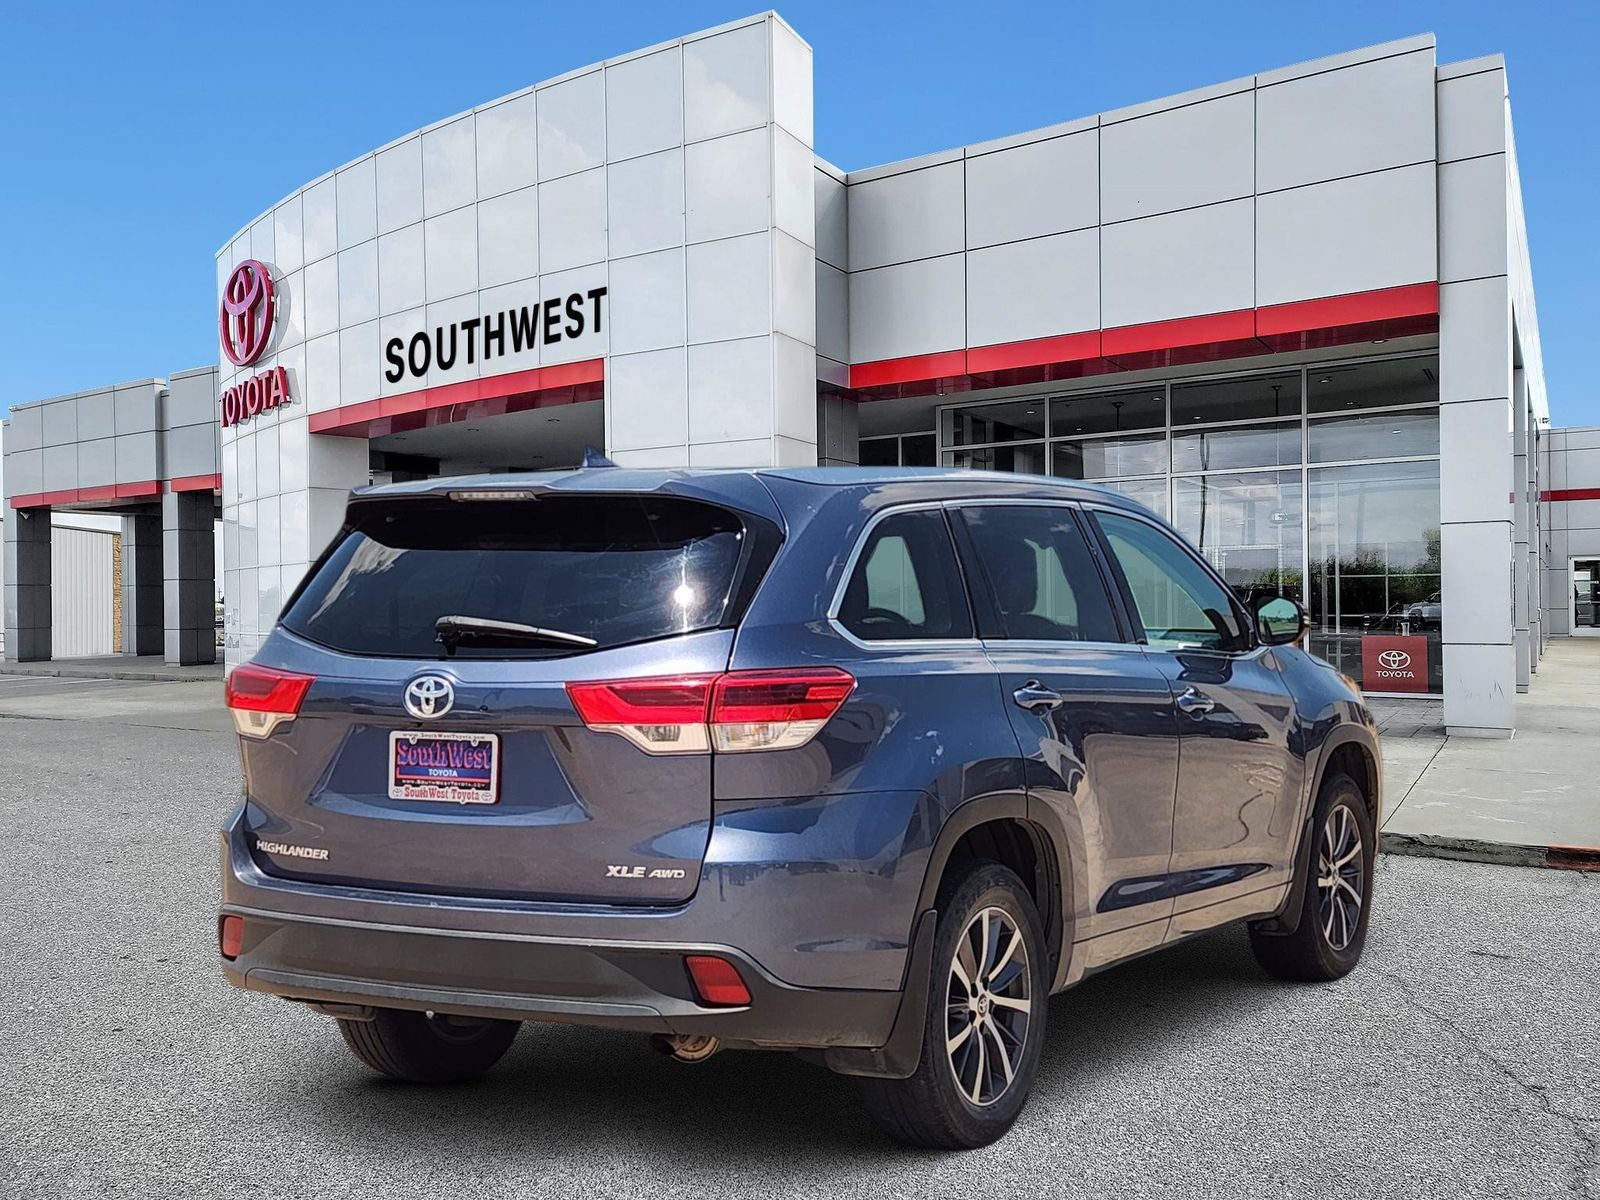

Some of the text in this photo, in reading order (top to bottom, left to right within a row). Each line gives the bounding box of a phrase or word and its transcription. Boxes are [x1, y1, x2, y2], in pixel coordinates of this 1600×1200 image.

[385, 286, 608, 383] SOUTHWEST
[219, 366, 291, 428] TOYOTA
[1376, 670, 1414, 678] TOYOTA
[428, 768, 458, 777] TOYOTA
[451, 788, 480, 802] Toyota
[256, 840, 329, 860] HIGHLANDER
[605, 865, 685, 878] XLE AWD
